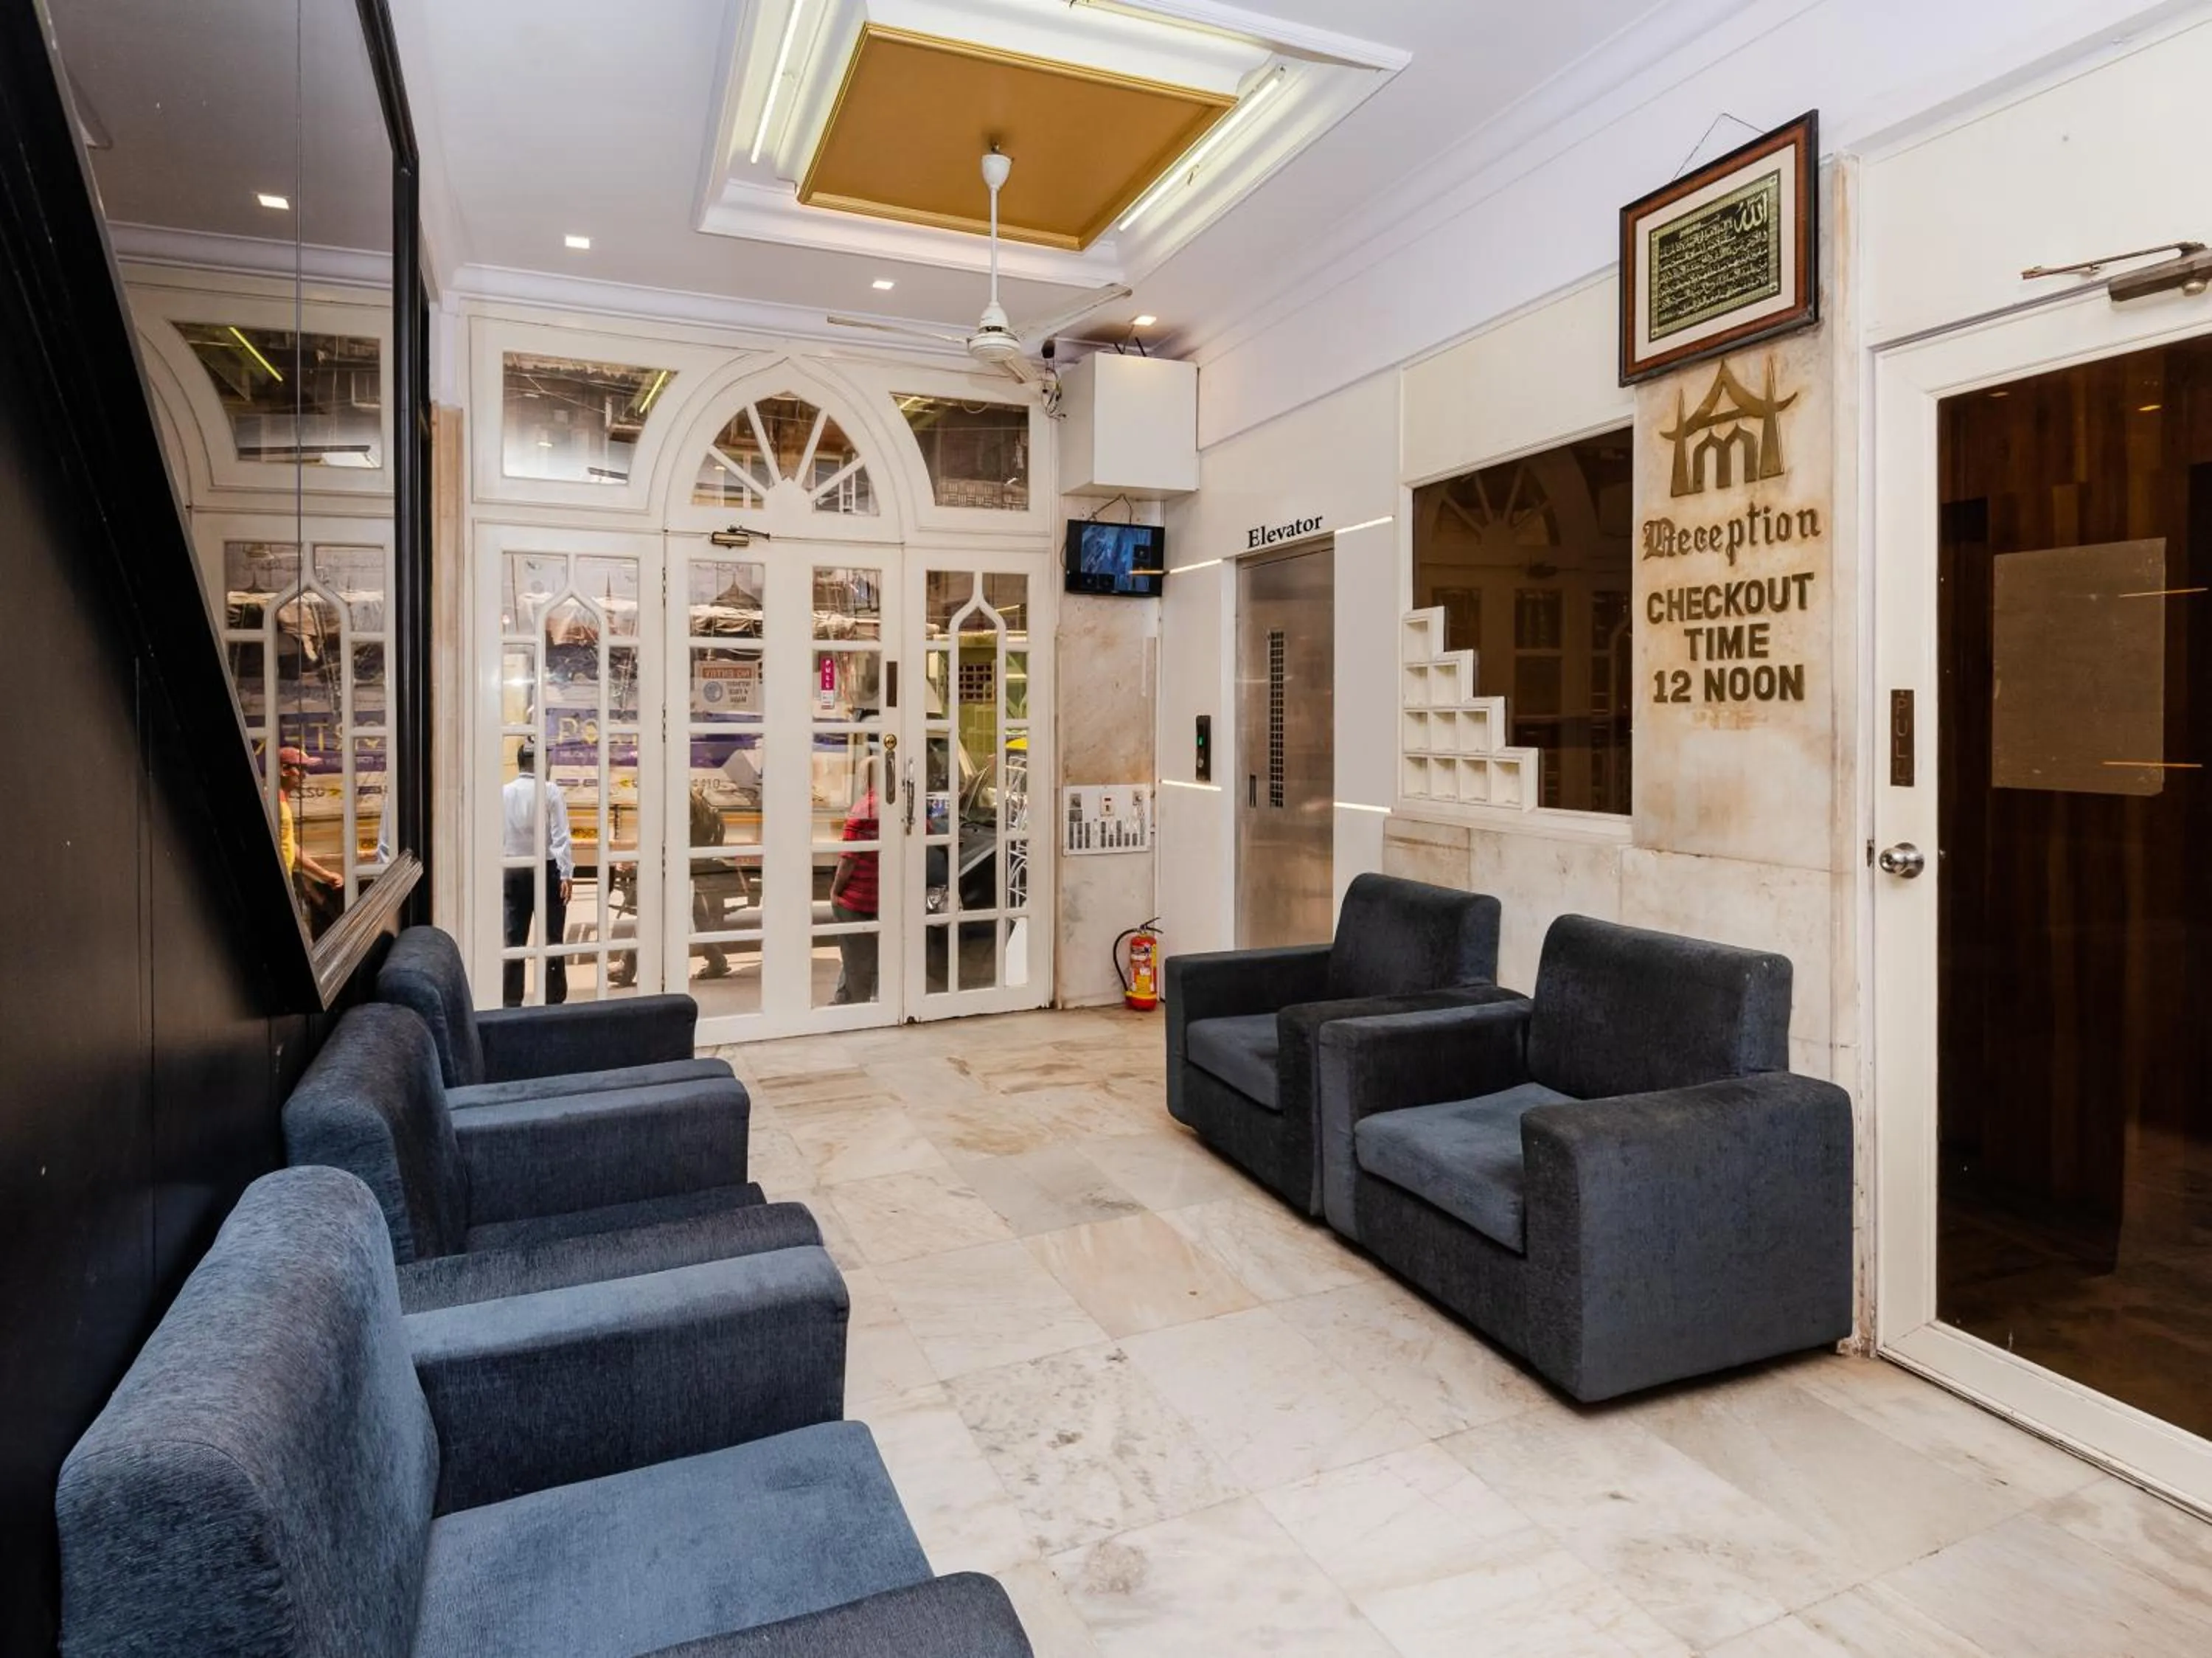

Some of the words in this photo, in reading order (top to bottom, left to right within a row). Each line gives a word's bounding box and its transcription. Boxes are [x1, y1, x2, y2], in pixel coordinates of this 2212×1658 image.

[1247, 515, 1324, 549] Elevator
[1641, 501, 1822, 567] Reception
[1646, 572, 1815, 625] CHECKOUT
[1683, 622, 1770, 662] TIME
[1653, 669, 1692, 703] 12
[1704, 664, 1805, 702] NOON
[1896, 696, 1909, 780] PULL
